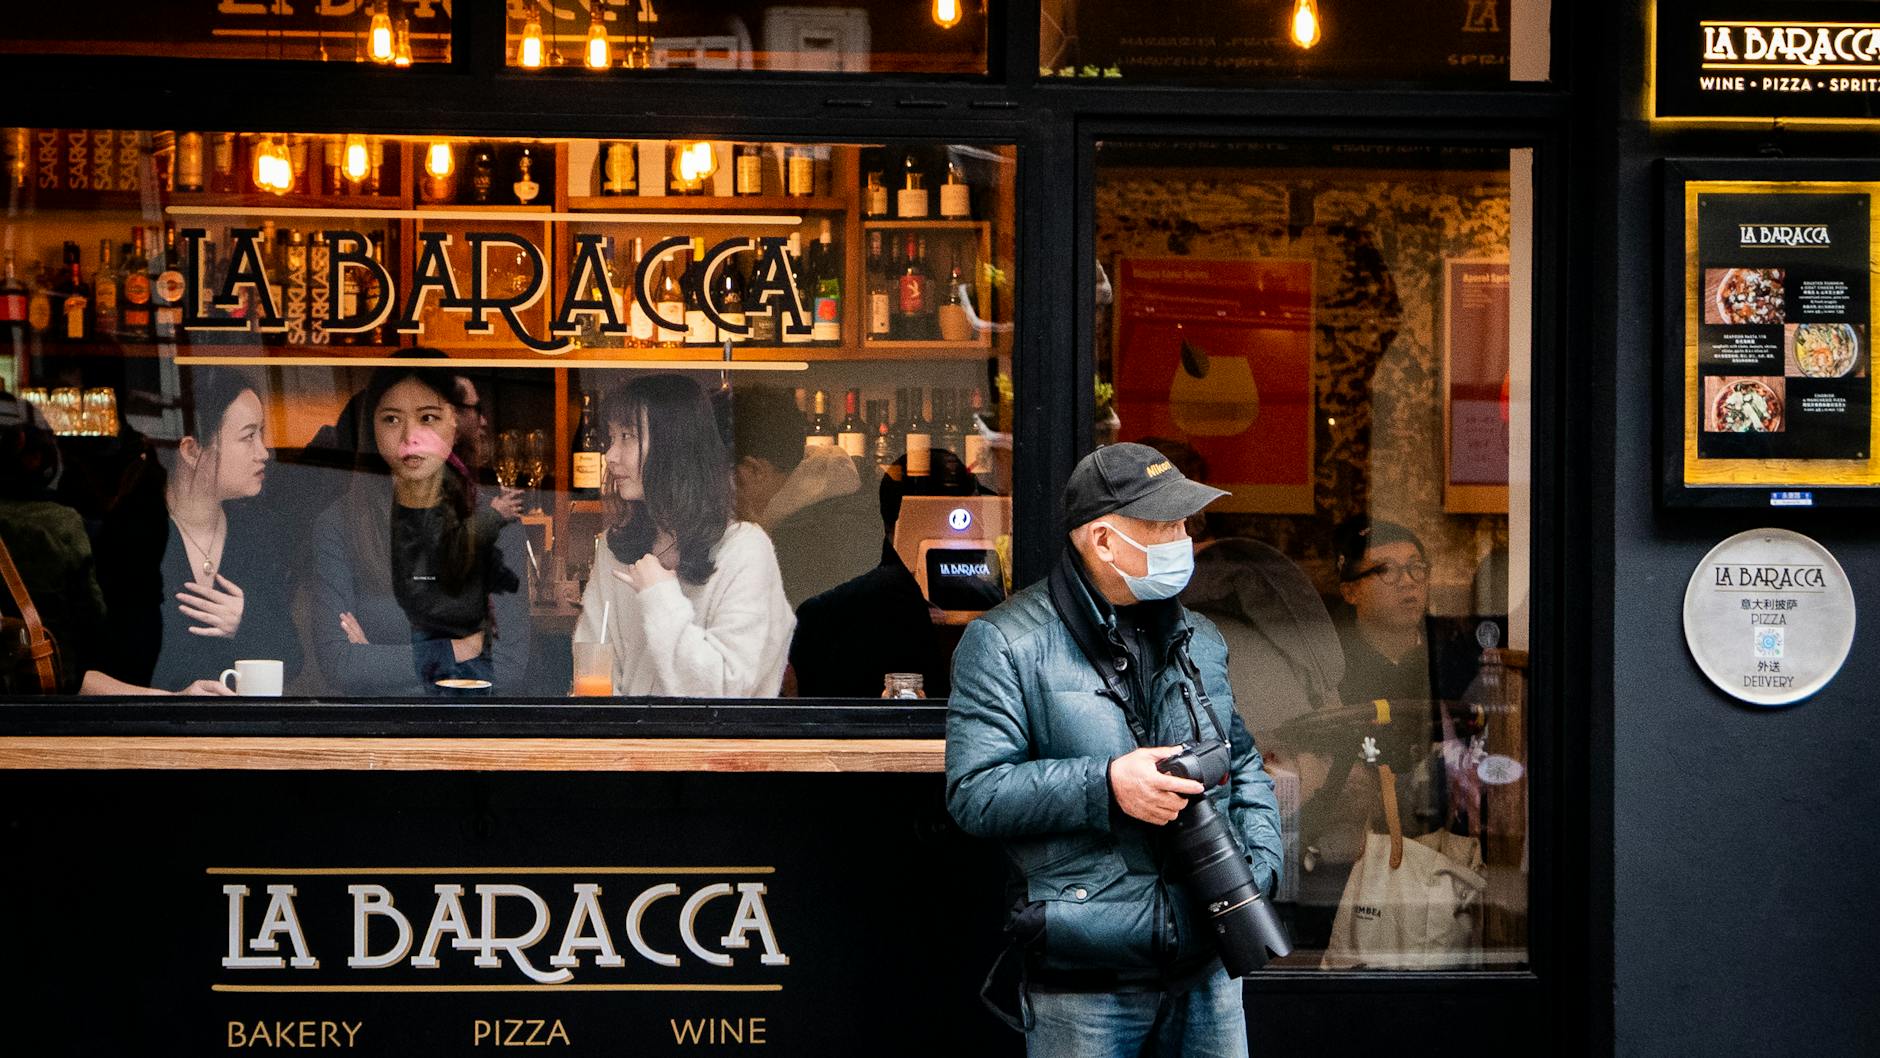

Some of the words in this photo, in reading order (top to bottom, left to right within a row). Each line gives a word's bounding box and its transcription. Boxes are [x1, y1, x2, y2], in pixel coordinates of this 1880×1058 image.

[1703, 27, 1738, 60] LA
[1700, 77, 1745, 91] WINE
[1762, 78, 1812, 91] PIZZA
[1829, 78, 1880, 92] SPRIT
[1740, 227, 1757, 244] LA
[1760, 227, 1831, 246] BARACCA
[181, 228, 289, 333] LA
[321, 230, 815, 356] BARACCA
[940, 563, 950, 574] LA
[951, 563, 990, 576] BARACCA
[1715, 567, 1734, 586] LA
[1739, 567, 1826, 590] BARACCA
[1741, 599, 1798, 610] 意大利披萨
[1751, 613, 1787, 625] PIZZA
[1757, 661, 1780, 673] 外送
[1743, 676, 1794, 688] DELIVERY
[222, 884, 319, 969] LA
[347, 882, 790, 984] BARACCA
[227, 1020, 363, 1049] BAKERY
[474, 1019, 571, 1047] PIZZA
[670, 1017, 767, 1045] WINE
